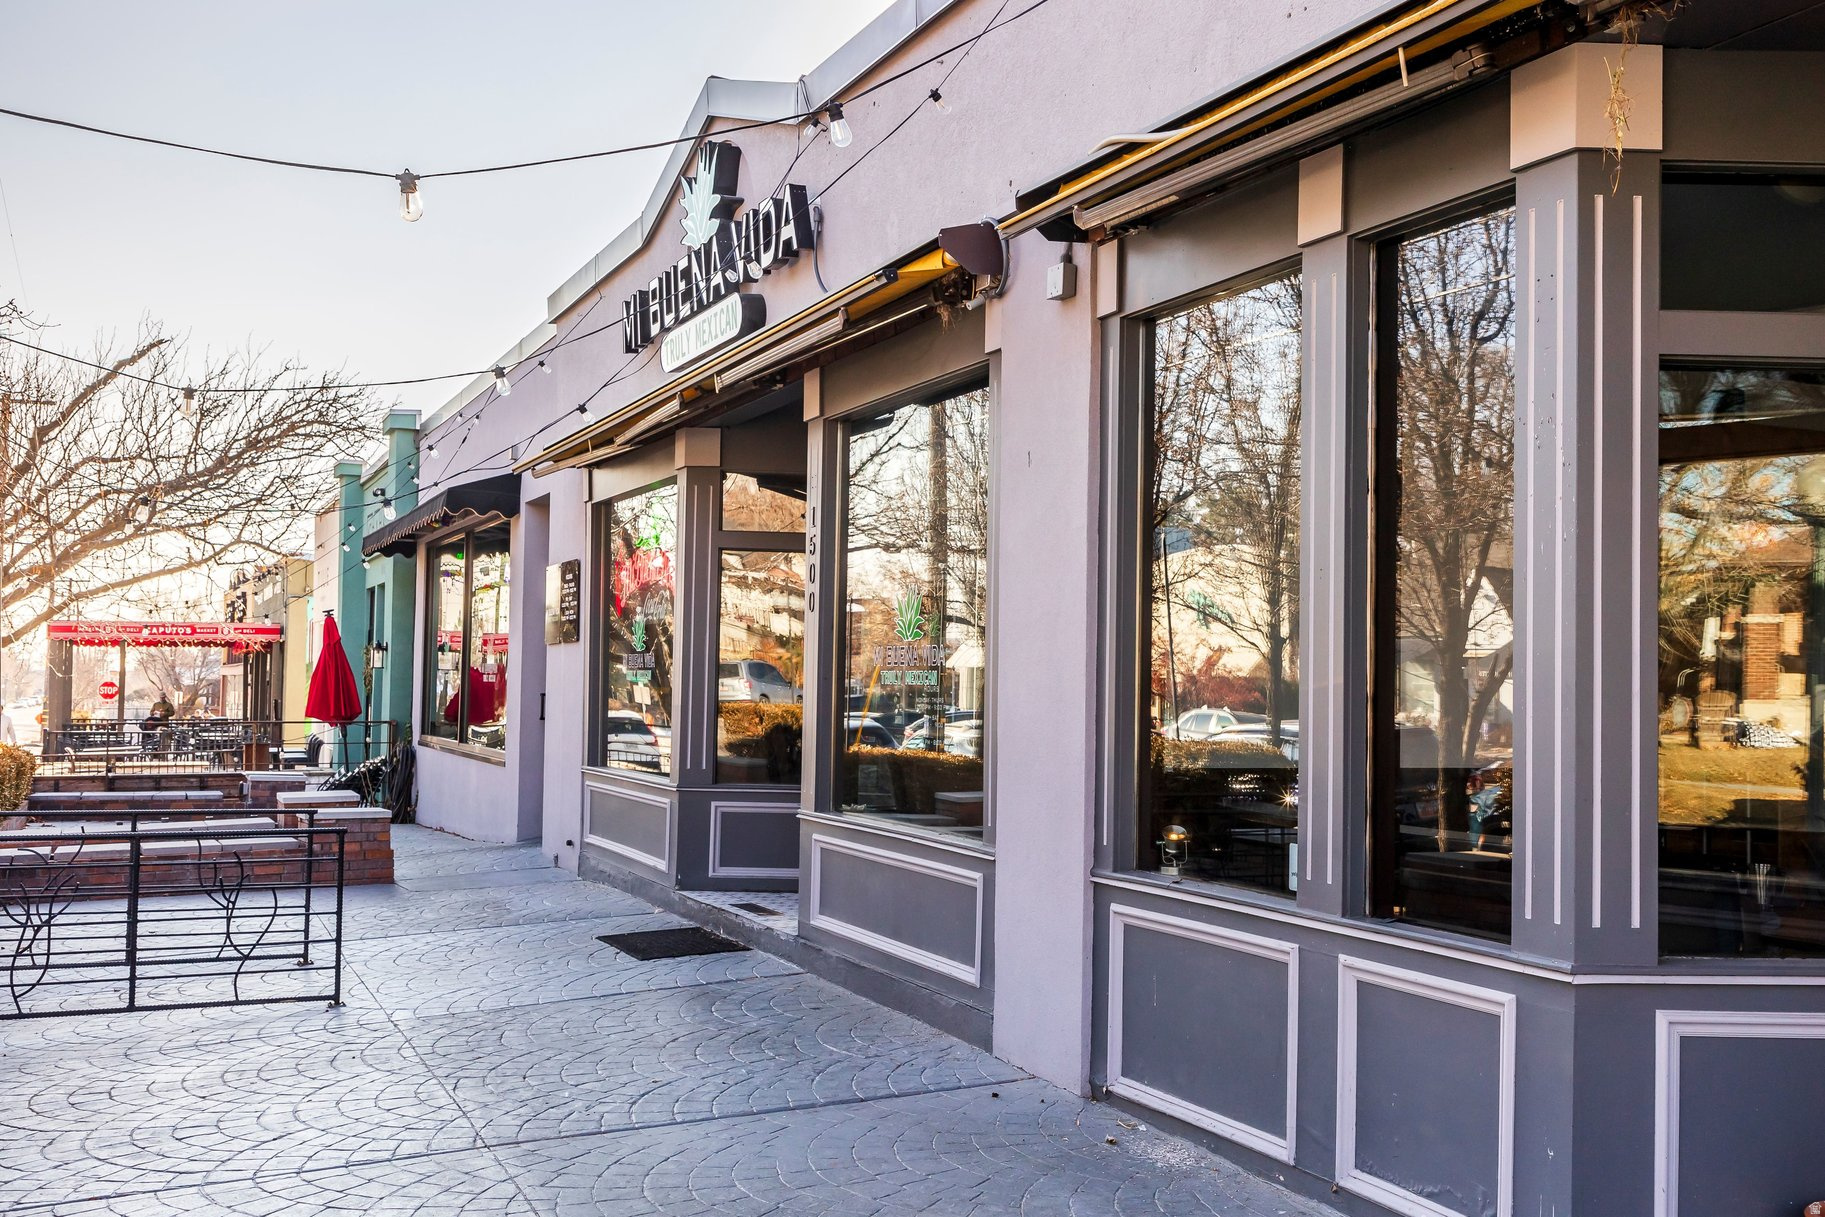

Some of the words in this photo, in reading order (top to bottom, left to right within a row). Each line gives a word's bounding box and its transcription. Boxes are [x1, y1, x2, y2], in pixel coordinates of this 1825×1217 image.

[622, 289, 645, 354] MI
[648, 235, 726, 337] BUENA
[730, 183, 803, 284] VIDA
[664, 329, 692, 367] TRULY
[694, 300, 739, 351] MEXICAN
[808, 506, 817, 613] 1500
[880, 670, 902, 685] TRULY
[905, 670, 938, 686] MEXICAN
[886, 644, 920, 667] BUENA
[922, 644, 946, 667] VIDA
[99, 686, 119, 695] STOP
